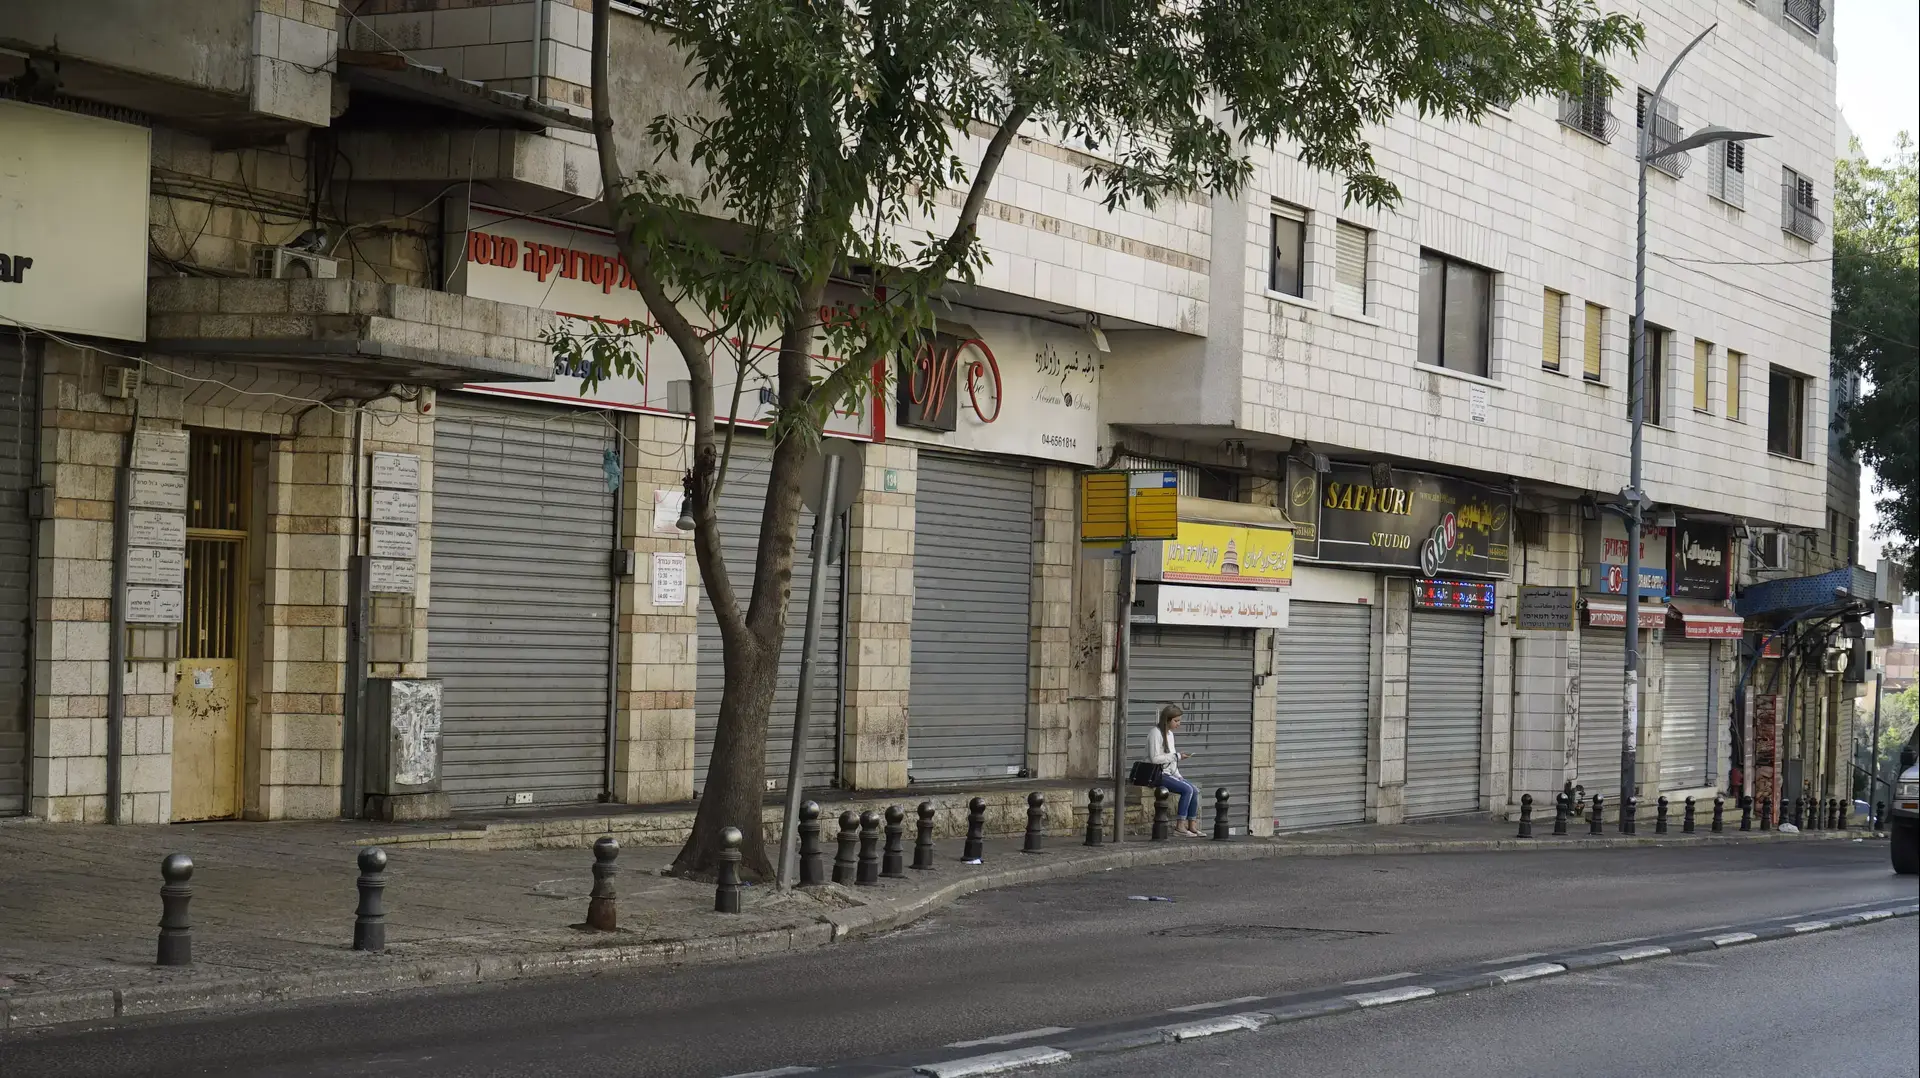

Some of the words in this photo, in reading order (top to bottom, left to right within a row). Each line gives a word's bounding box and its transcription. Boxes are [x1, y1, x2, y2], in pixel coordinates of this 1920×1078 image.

[1041, 433, 1076, 449] 04-6561814
[1326, 481, 1414, 516] SAFFURI
[1370, 532, 1411, 549] STUDIO
